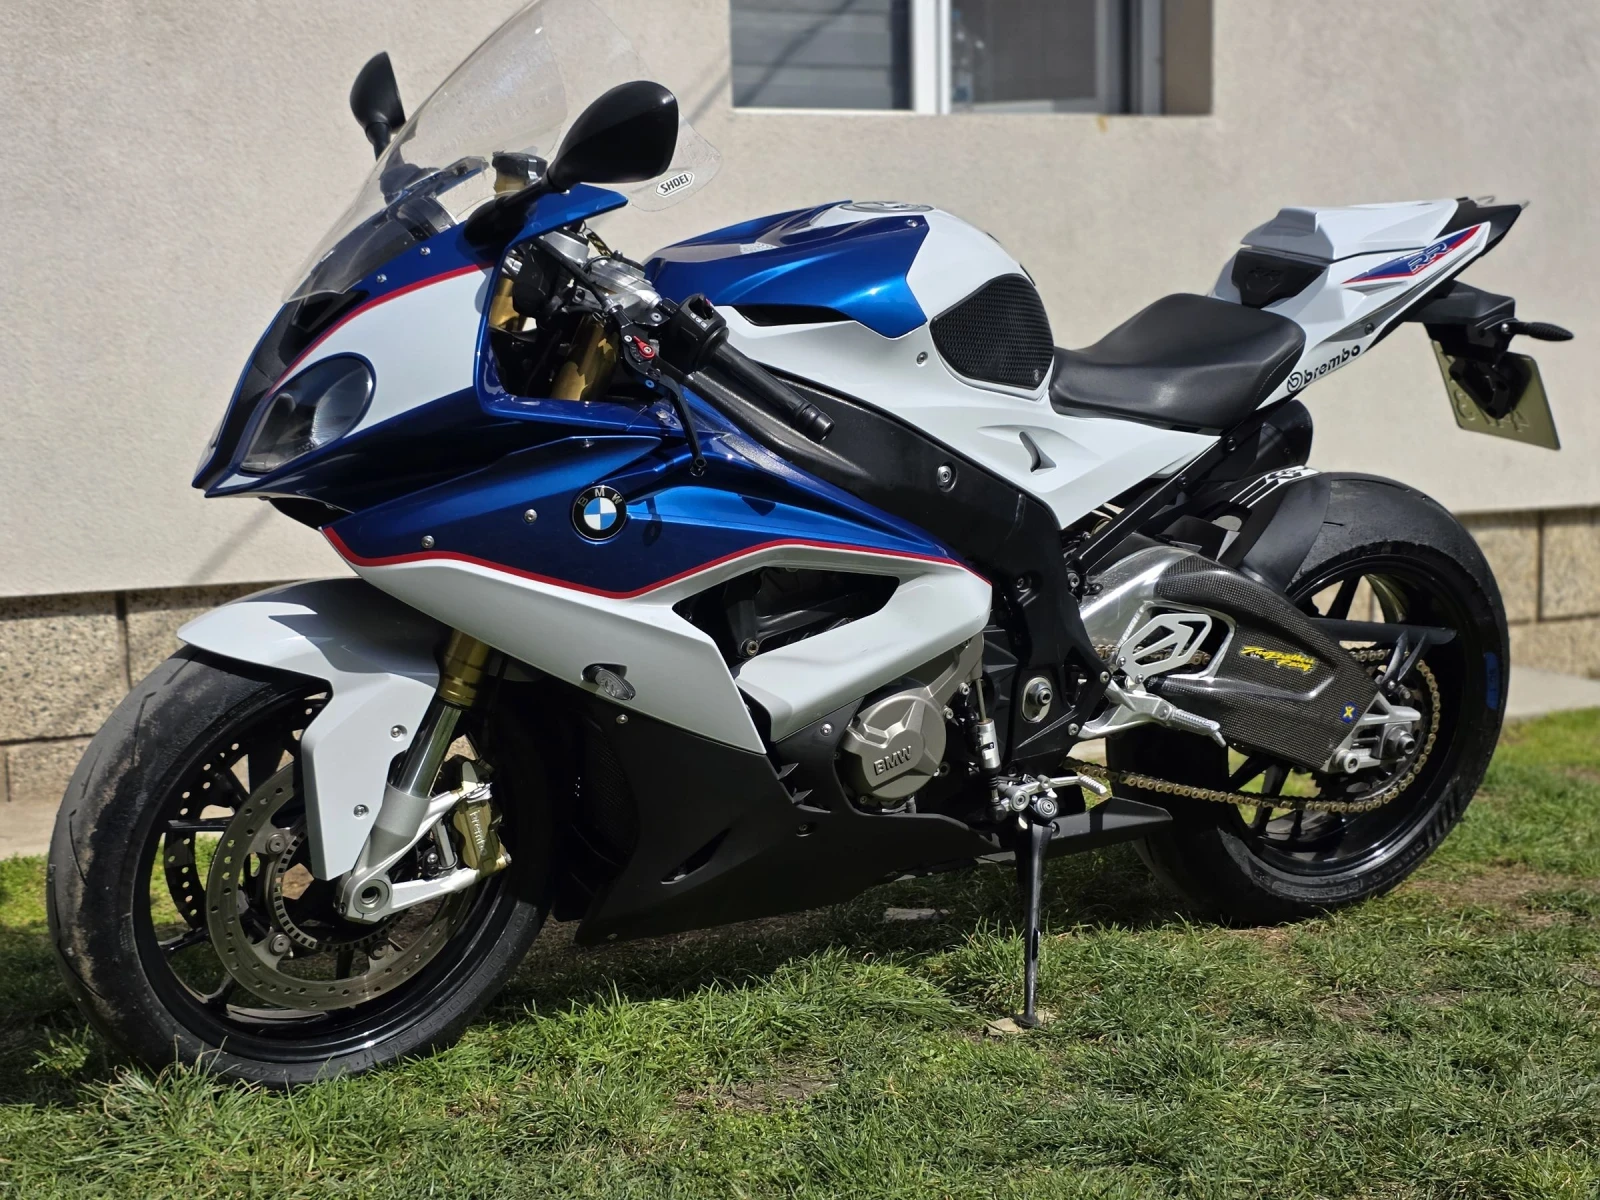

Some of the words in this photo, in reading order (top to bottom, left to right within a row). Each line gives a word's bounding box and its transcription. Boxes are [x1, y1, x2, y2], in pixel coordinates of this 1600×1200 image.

[660, 173, 690, 194] SHOEI
[1407, 242, 1452, 273] RR
[1303, 344, 1361, 385] brembo
[577, 488, 623, 508] BMW
[873, 745, 912, 776] BMW
